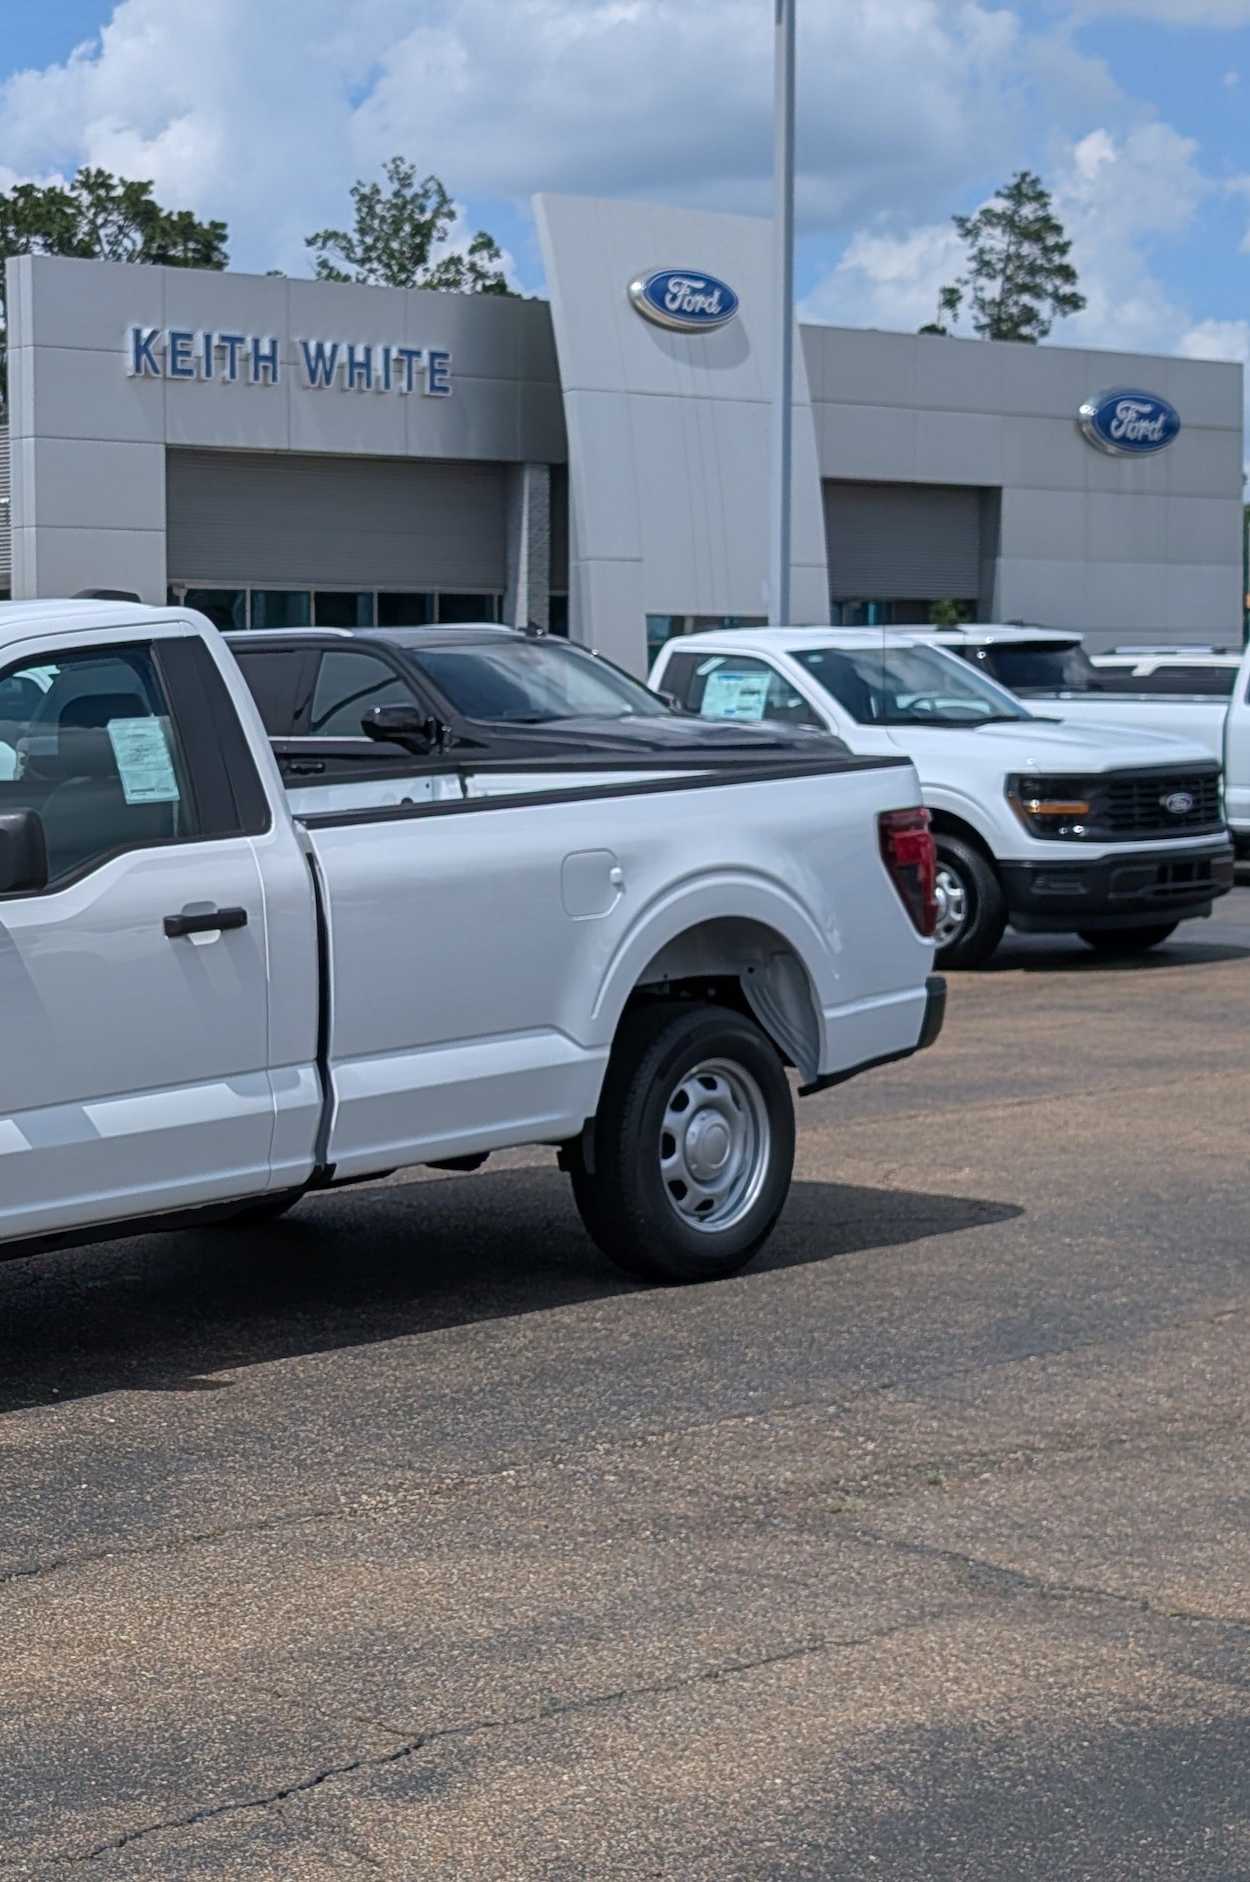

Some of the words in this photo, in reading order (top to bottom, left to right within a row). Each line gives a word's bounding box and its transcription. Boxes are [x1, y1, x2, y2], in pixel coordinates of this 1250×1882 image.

[664, 276, 723, 315] Ford
[129, 327, 280, 385] KEITH
[299, 340, 451, 396] WHITE
[1110, 400, 1167, 441] Ford
